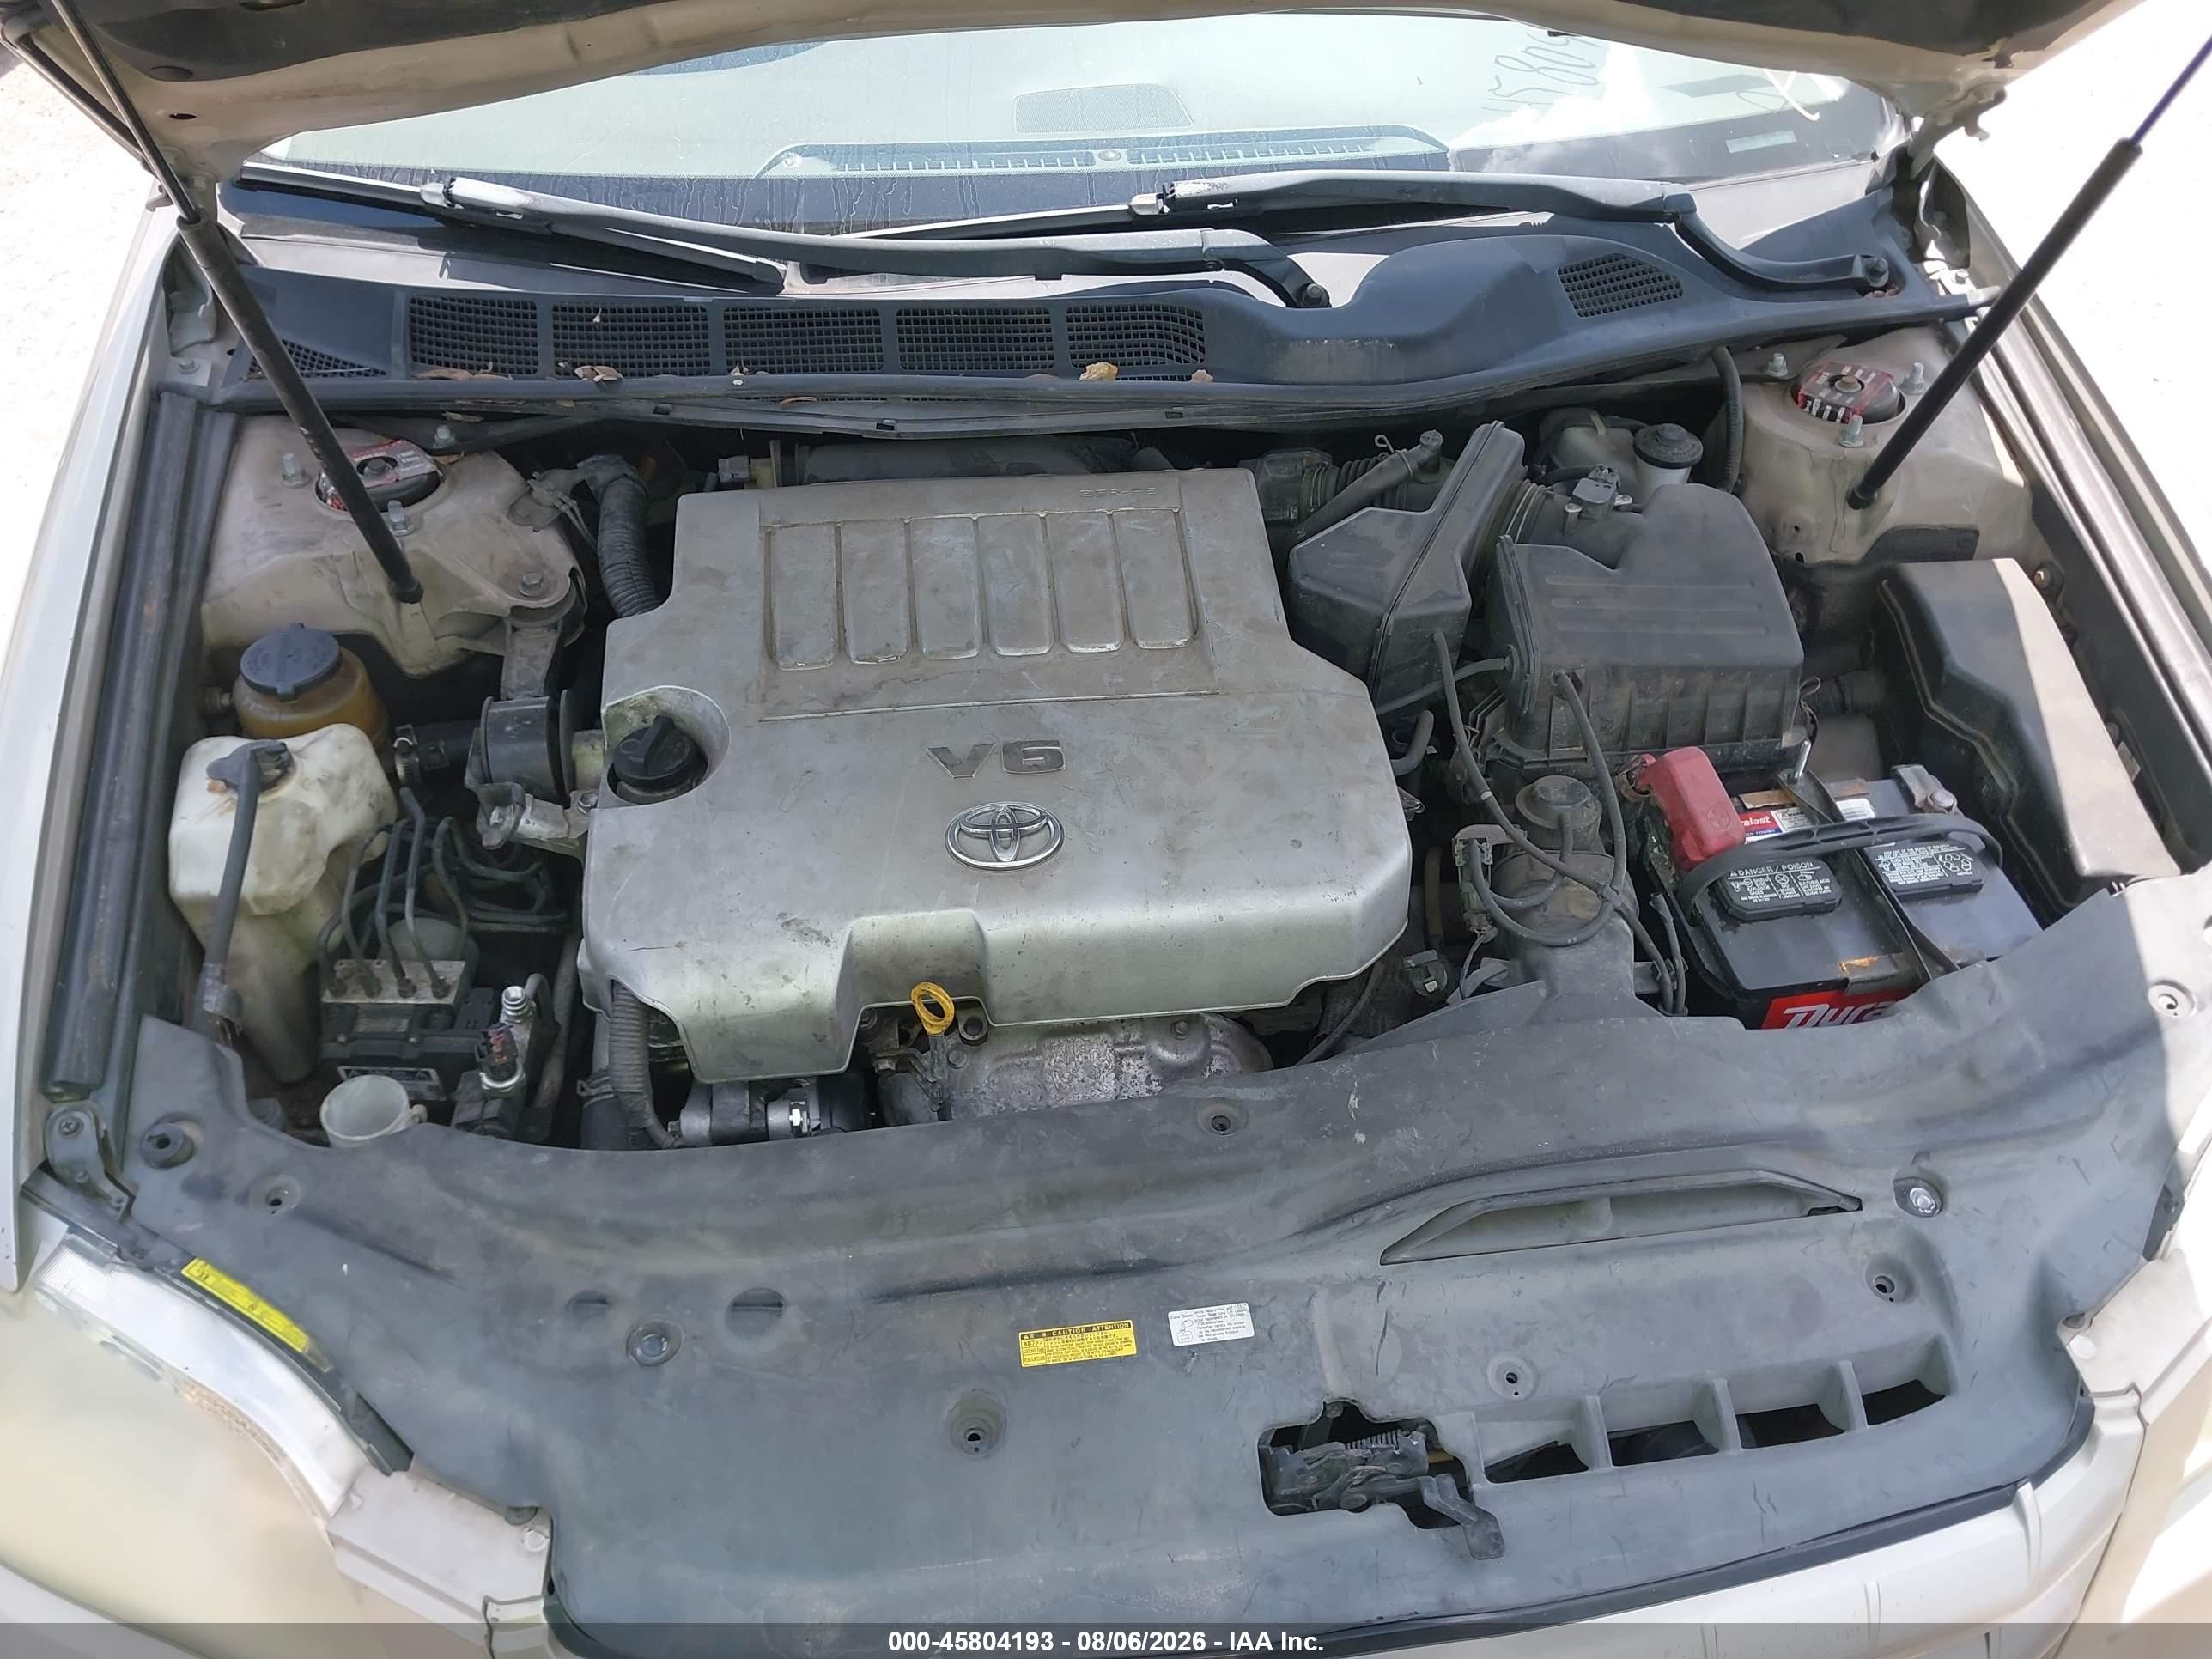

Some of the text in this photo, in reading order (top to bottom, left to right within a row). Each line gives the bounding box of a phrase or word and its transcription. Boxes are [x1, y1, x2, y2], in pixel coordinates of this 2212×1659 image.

[926, 739, 1066, 780] V6
[1737, 866, 1774, 877] DANGER
[1780, 861, 1814, 871] POISON
[1051, 1328, 1086, 1336] CAUTION
[1092, 1322, 1129, 1331] ATTENTION
